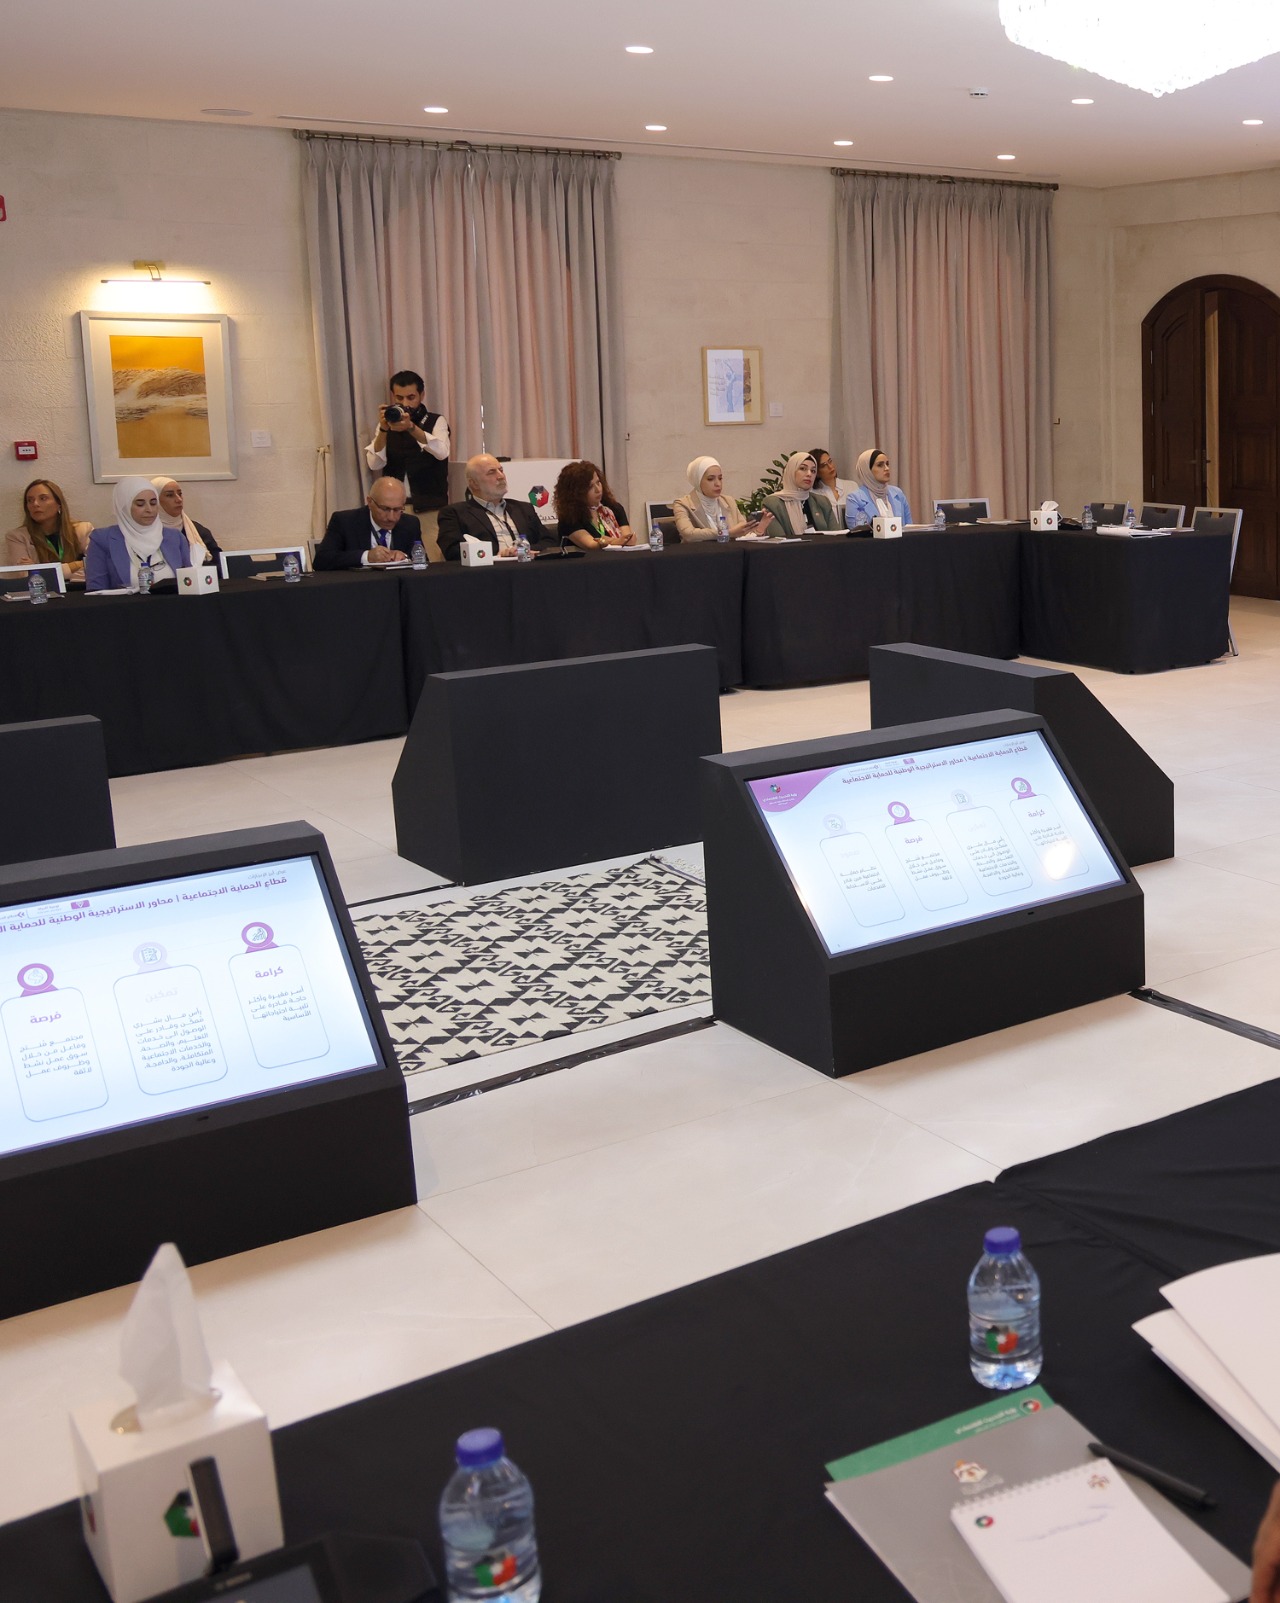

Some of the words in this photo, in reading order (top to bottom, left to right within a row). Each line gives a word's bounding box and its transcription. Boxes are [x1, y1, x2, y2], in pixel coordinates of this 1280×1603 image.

[994, 748, 1013, 757] الحماية
[1013, 745, 1028, 754] قطاع
[949, 756, 964, 766] محاور
[968, 750, 994, 761] الاجتماعية
[872, 769, 893, 780] للحماية
[894, 766, 915, 776] الوطنية
[843, 774, 871, 784] الاجتماعية
[1028, 809, 1045, 817] كرامة
[905, 836, 923, 844] فرصة
[230, 880, 262, 893] الحماية
[264, 877, 287, 889] قطاع
[182, 886, 228, 902] الاجتماعية
[148, 898, 174, 909] محاور
[88, 901, 145, 918] الاستراتيجية
[48, 911, 86, 925] الوطنية
[10, 919, 46, 932] للحماية
[255, 966, 284, 978] كرامة
[30, 1010, 62, 1024] فرصة
[165, 1012, 187, 1023] مال
[46, 1056, 64, 1066] عمل
[26, 1068, 52, 1079] عمل
